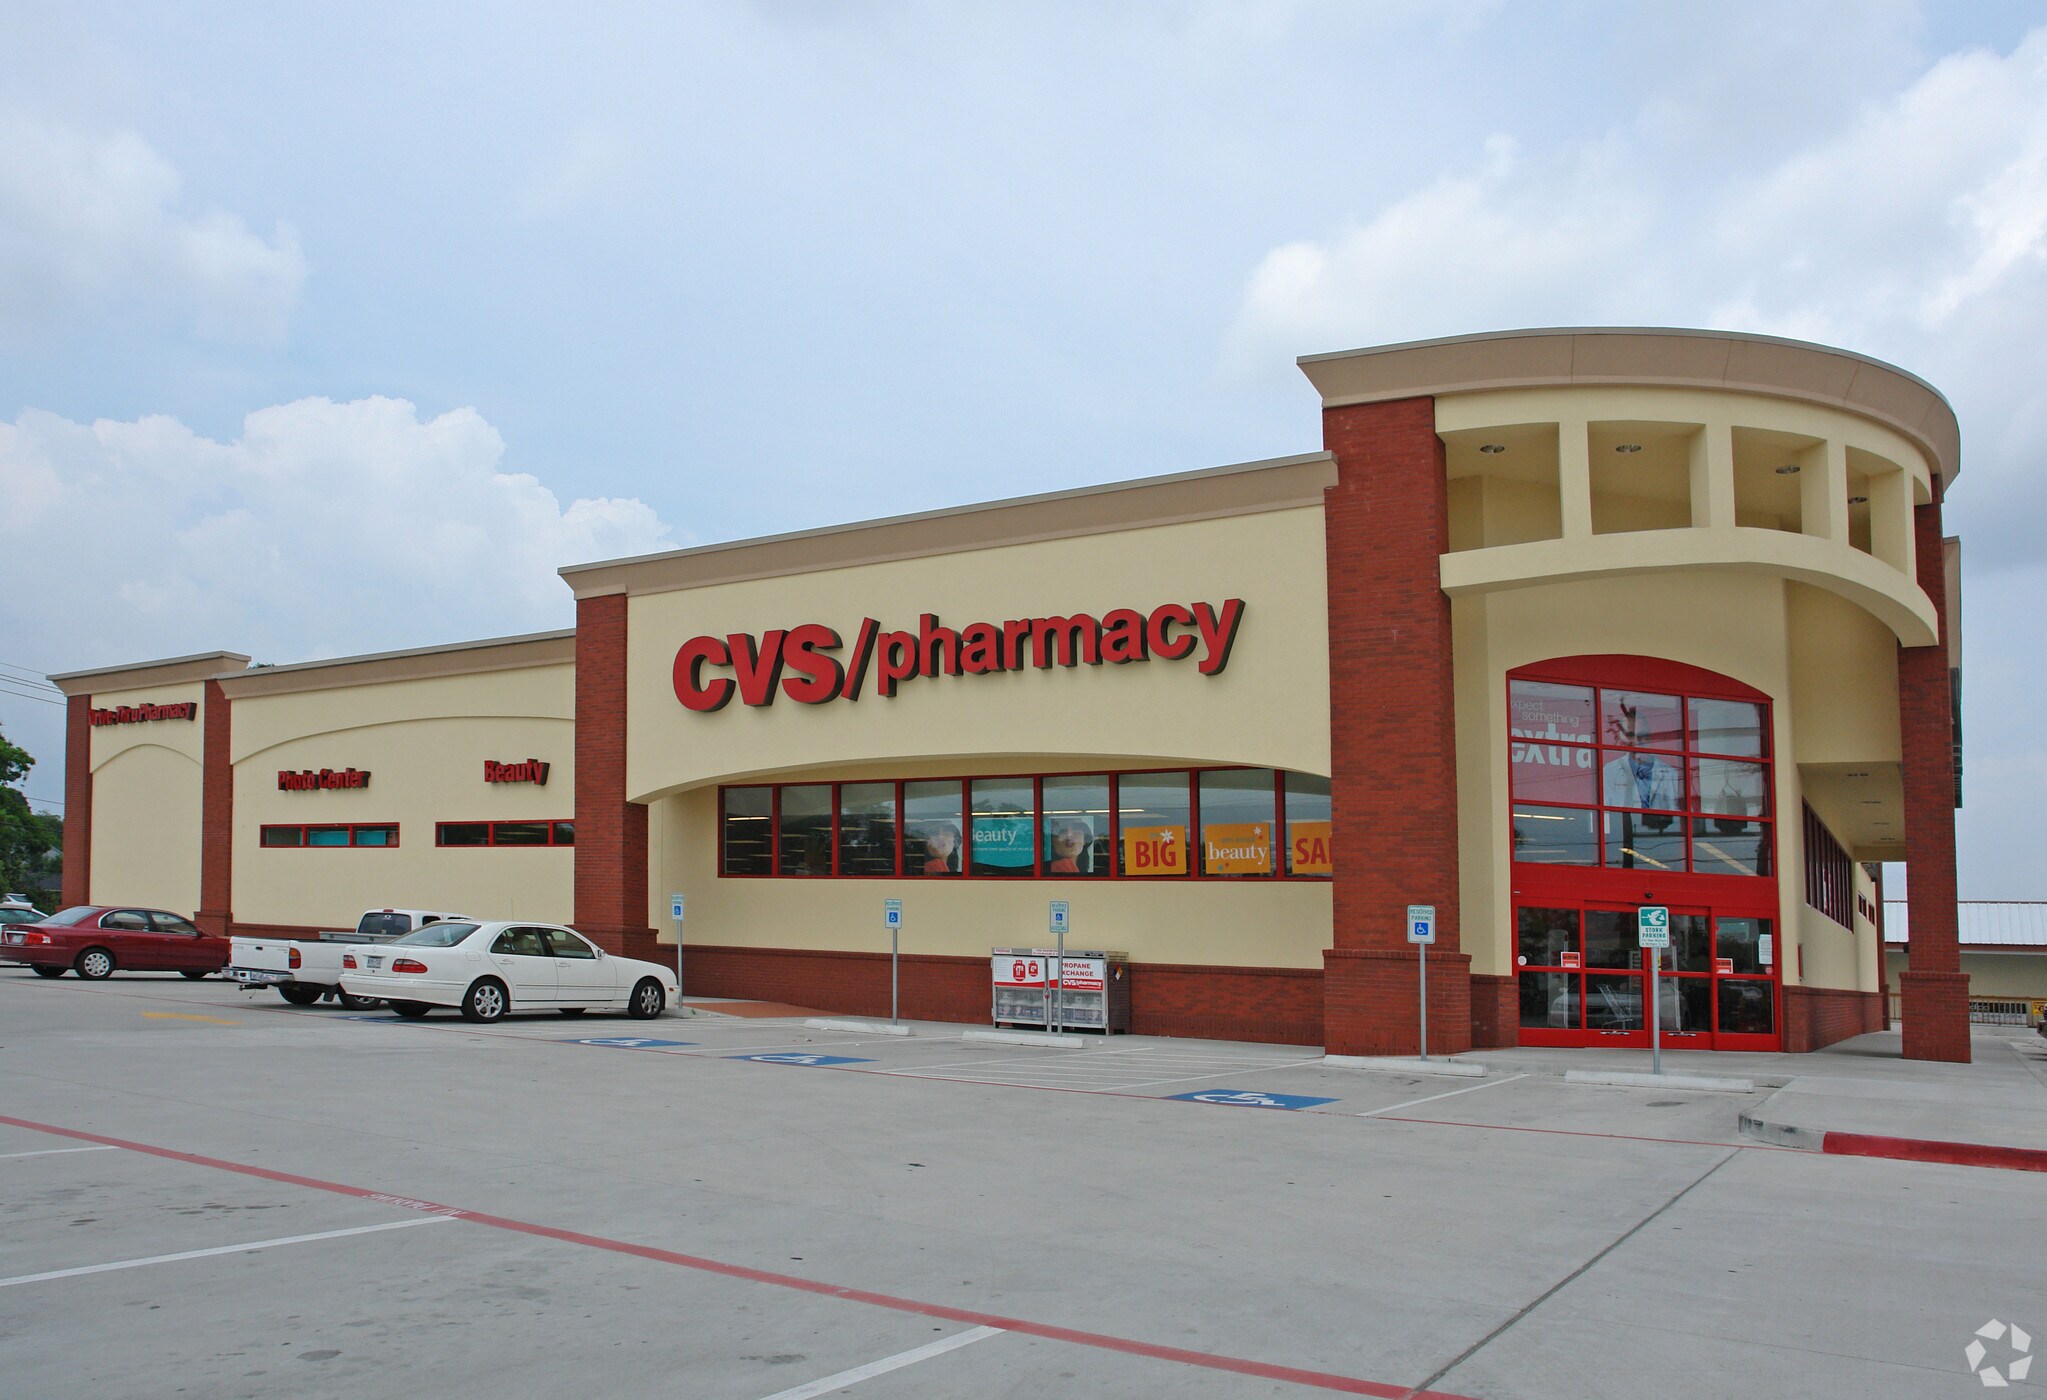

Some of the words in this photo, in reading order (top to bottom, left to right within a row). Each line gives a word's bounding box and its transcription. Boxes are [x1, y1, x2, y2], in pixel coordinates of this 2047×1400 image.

[673, 598, 1246, 712] CVS/pharmacy
[139, 703, 197, 721] Pharmacy
[1512, 701, 1543, 712] xpect
[1522, 711, 1579, 728] something
[1511, 723, 1592, 768] extra
[278, 770, 319, 790] Photo
[319, 767, 371, 789] Center
[484, 759, 550, 786] Beauty
[972, 828, 1017, 845] eauty
[1135, 839, 1176, 868] BIG
[1208, 842, 1268, 865] beauty
[1062, 979, 1103, 988] CVS/pharmacy
